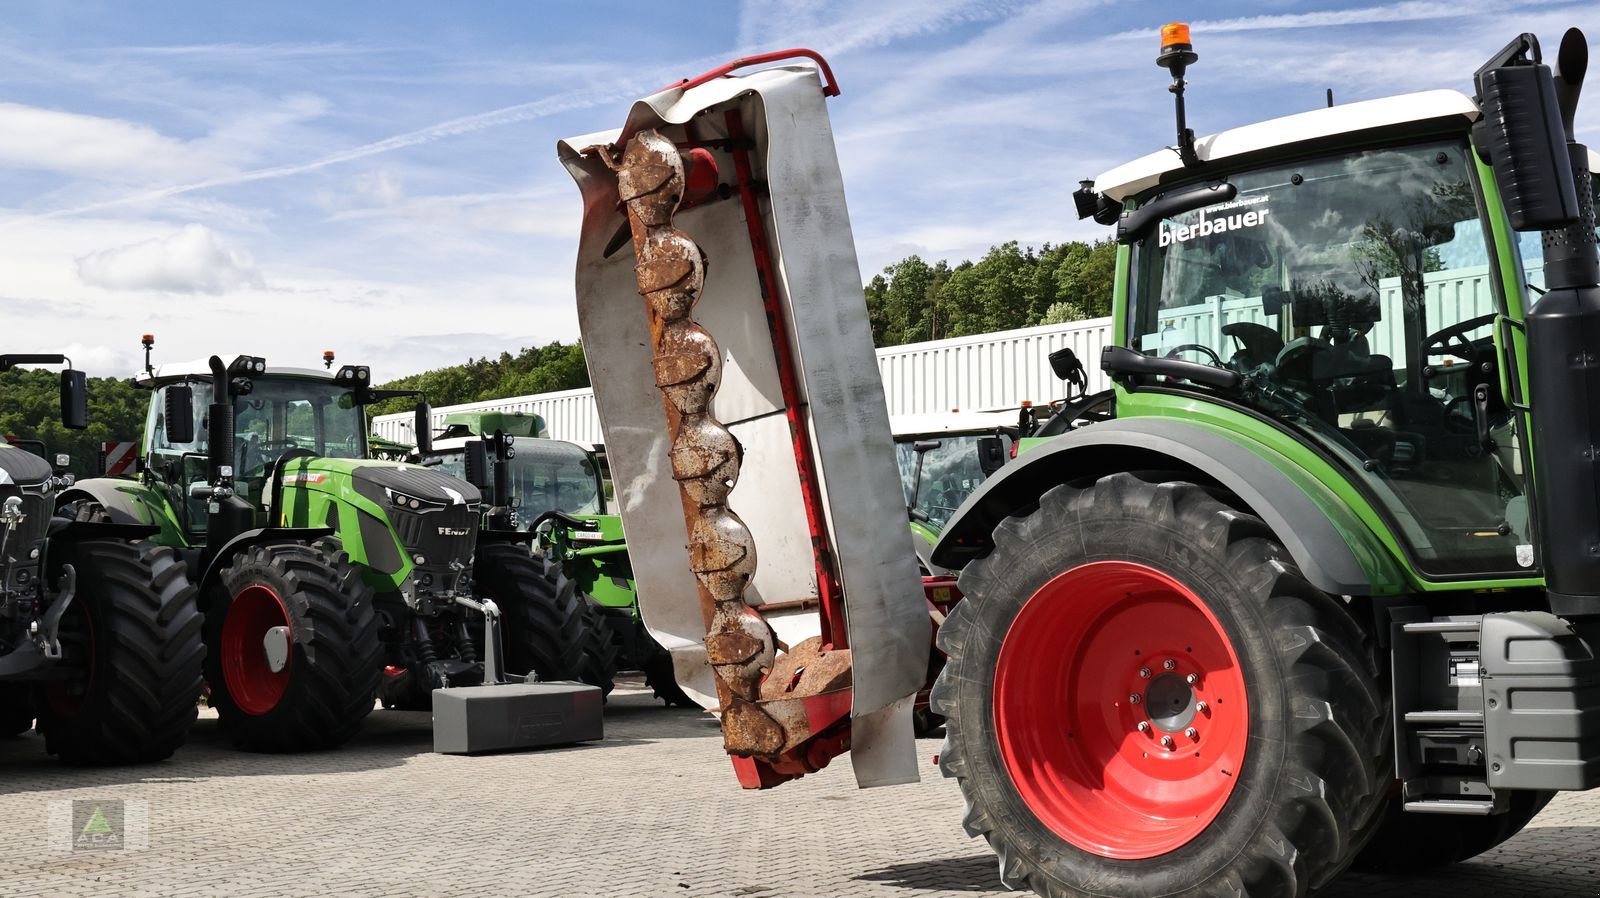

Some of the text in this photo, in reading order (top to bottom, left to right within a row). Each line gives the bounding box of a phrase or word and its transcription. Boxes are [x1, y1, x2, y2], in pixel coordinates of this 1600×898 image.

[1205, 195, 1269, 214] www.bierbauer.at
[1159, 209, 1269, 247] bierbauer
[438, 527, 470, 535] FENDT
